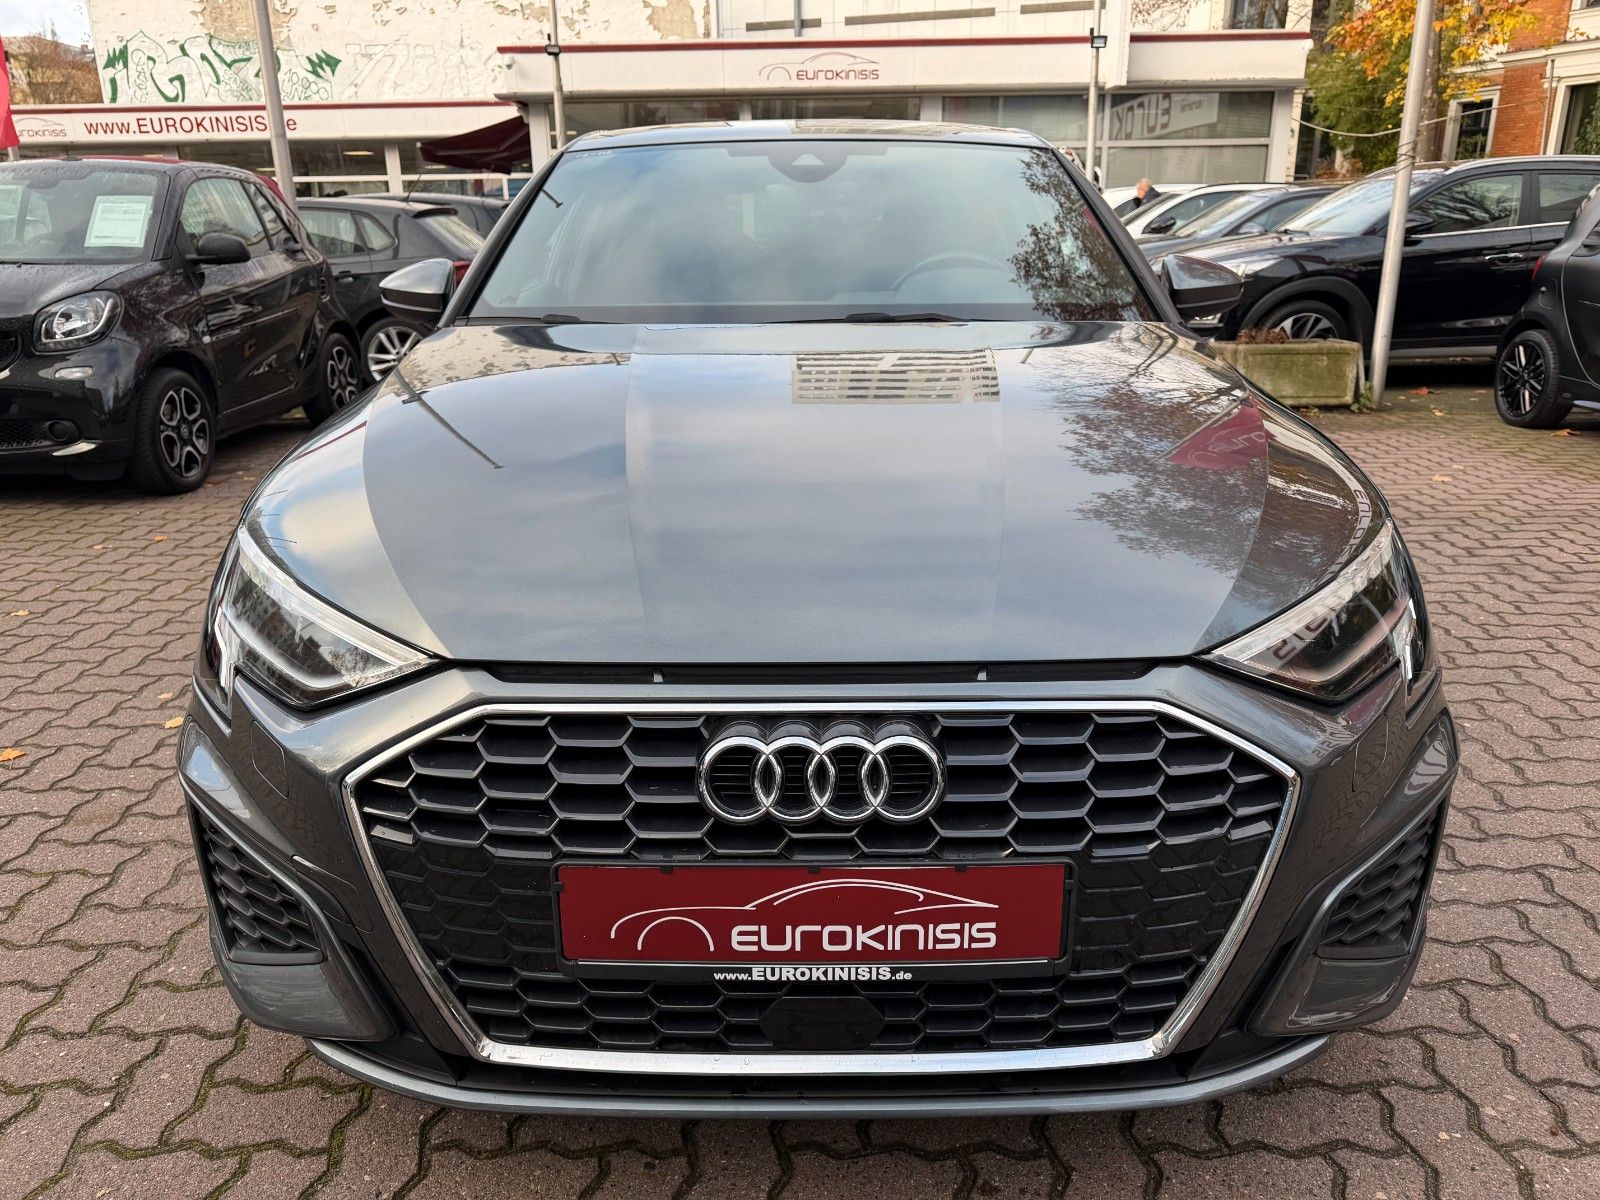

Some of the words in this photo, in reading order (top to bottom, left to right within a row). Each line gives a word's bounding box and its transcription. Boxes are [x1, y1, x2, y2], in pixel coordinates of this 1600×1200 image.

[84, 115, 297, 135] www.EUROKINISISe
[731, 922, 997, 951] EUROKINISIS
[713, 967, 913, 981] www.EUROKINISIS.de
